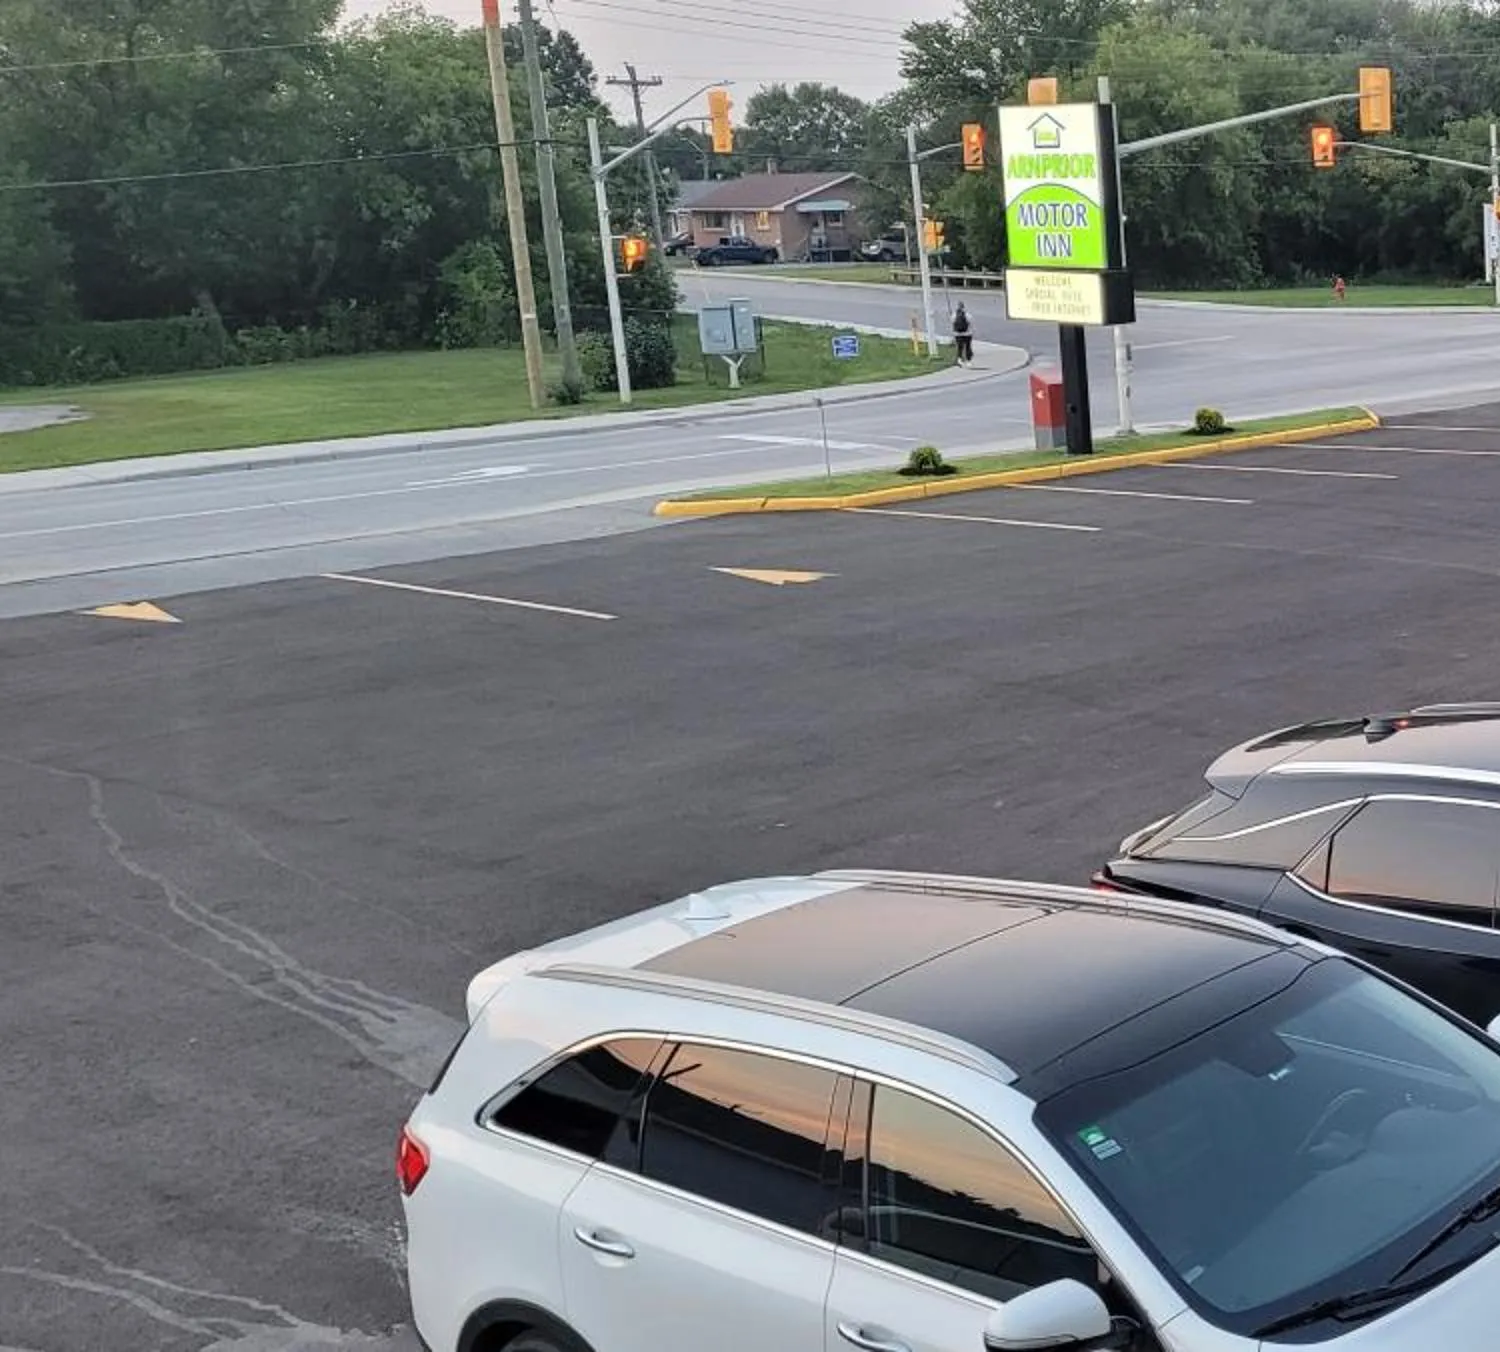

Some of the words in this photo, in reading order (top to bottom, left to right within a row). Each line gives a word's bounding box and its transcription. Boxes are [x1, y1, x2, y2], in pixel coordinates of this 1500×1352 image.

[1007, 153, 1096, 178] ARNPRIOR
[1018, 203, 1088, 227] MOTOR
[1037, 234, 1073, 257] INN
